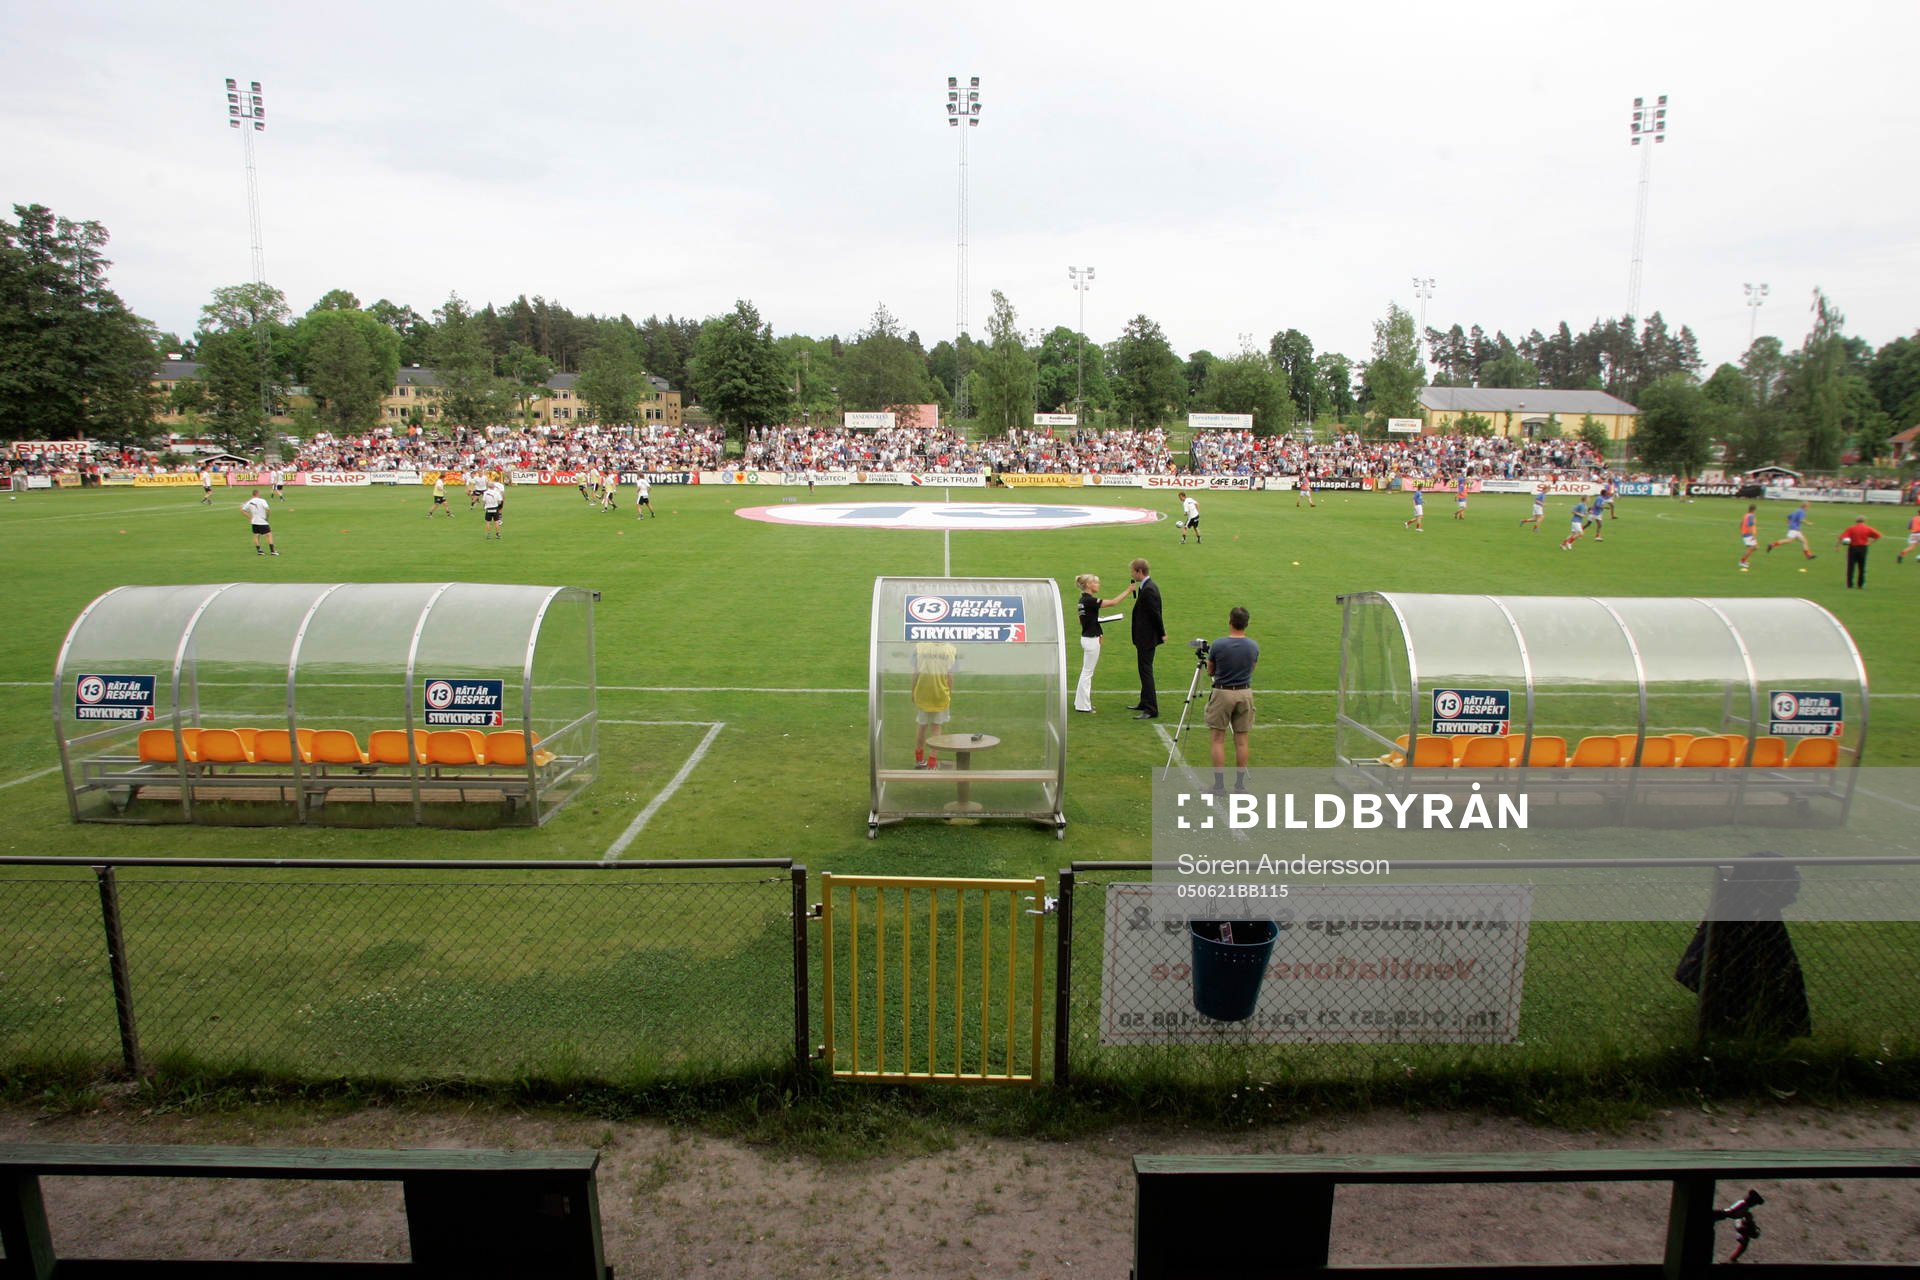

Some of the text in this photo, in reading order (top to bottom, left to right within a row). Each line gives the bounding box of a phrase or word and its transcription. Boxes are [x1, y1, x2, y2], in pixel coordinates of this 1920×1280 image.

[16, 443, 88, 453] SHARP
[310, 475, 366, 483] SHARP
[925, 476, 978, 484] SPEKTRUM
[1148, 477, 1205, 487] SHARP
[1296, 479, 1360, 490] snskaspel.se
[1537, 484, 1591, 493] SHARP
[1691, 486, 1739, 495] CANAL+
[916, 602, 942, 613] 13
[952, 600, 1002, 608] RÄTT ÄR
[951, 608, 1017, 617] RESPEKT
[910, 627, 1000, 639] STRYKTIPSET
[83, 684, 100, 696] 13
[107, 681, 141, 690] RÄTT ÄR
[432, 689, 449, 700] 13
[455, 686, 488, 695] RÄTT ÄR
[105, 691, 150, 700] RESPEKT
[454, 696, 498, 704] RESPEKT
[1463, 696, 1496, 704] RÄTT ÄR
[1440, 699, 1457, 710] 13
[1777, 701, 1793, 711] 13
[79, 708, 138, 718] STRYKTIPSET
[1462, 706, 1505, 714] RESPEKT
[428, 713, 486, 723] STRYKTIPSET
[1436, 723, 1494, 733] STRYKTIPSET
